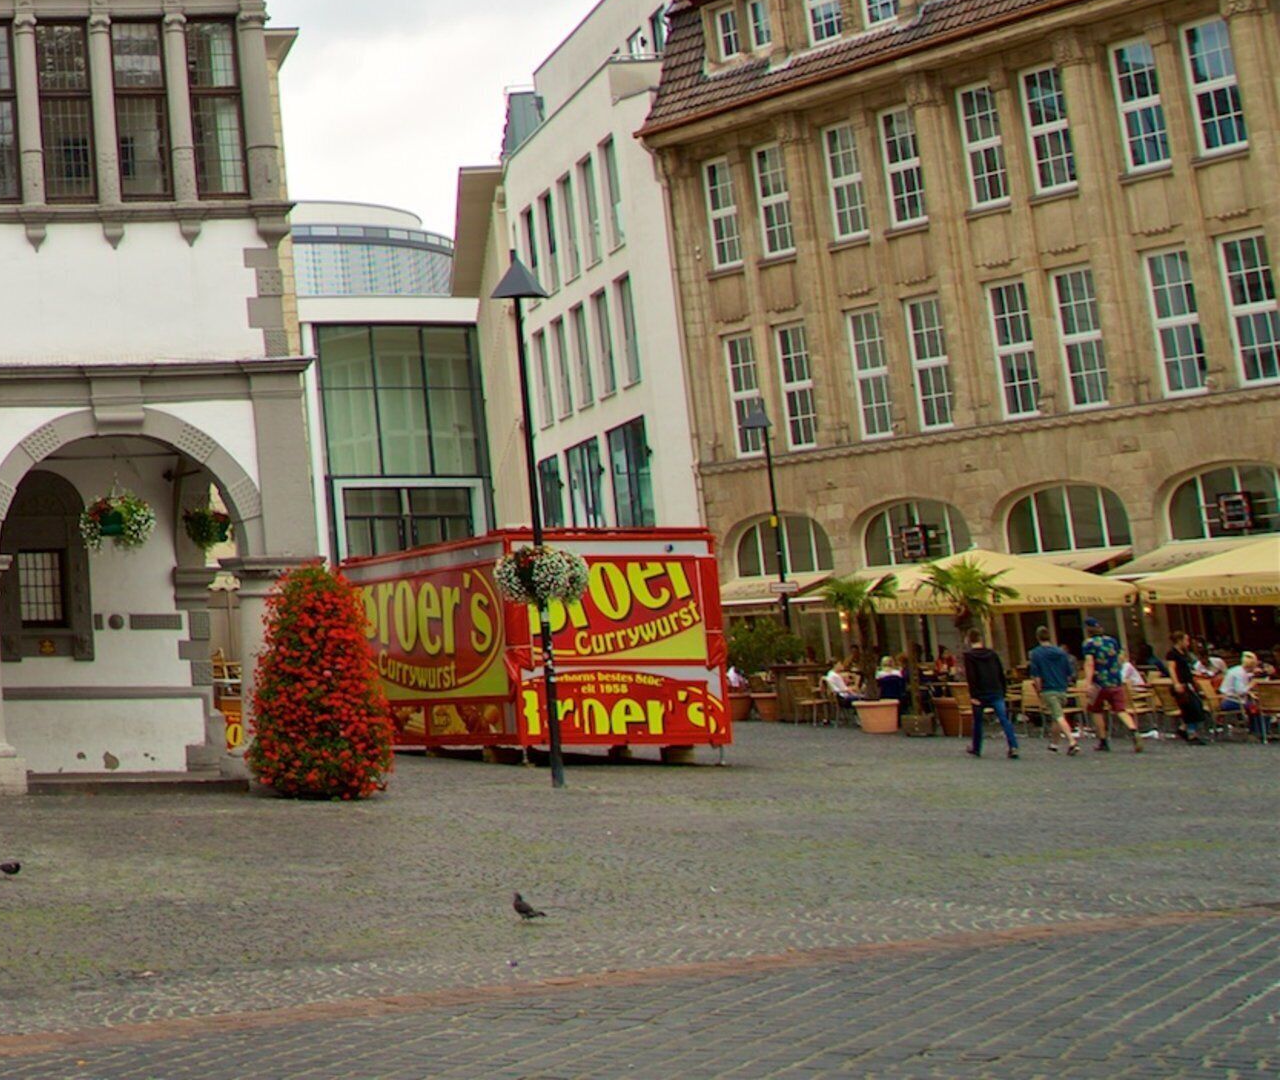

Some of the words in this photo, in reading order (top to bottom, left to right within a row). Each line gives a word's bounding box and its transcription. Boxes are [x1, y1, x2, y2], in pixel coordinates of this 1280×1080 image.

[574, 601, 702, 655] Currywurst
[378, 649, 457, 689] Currywurst
[635, 674, 664, 686] Stüc
